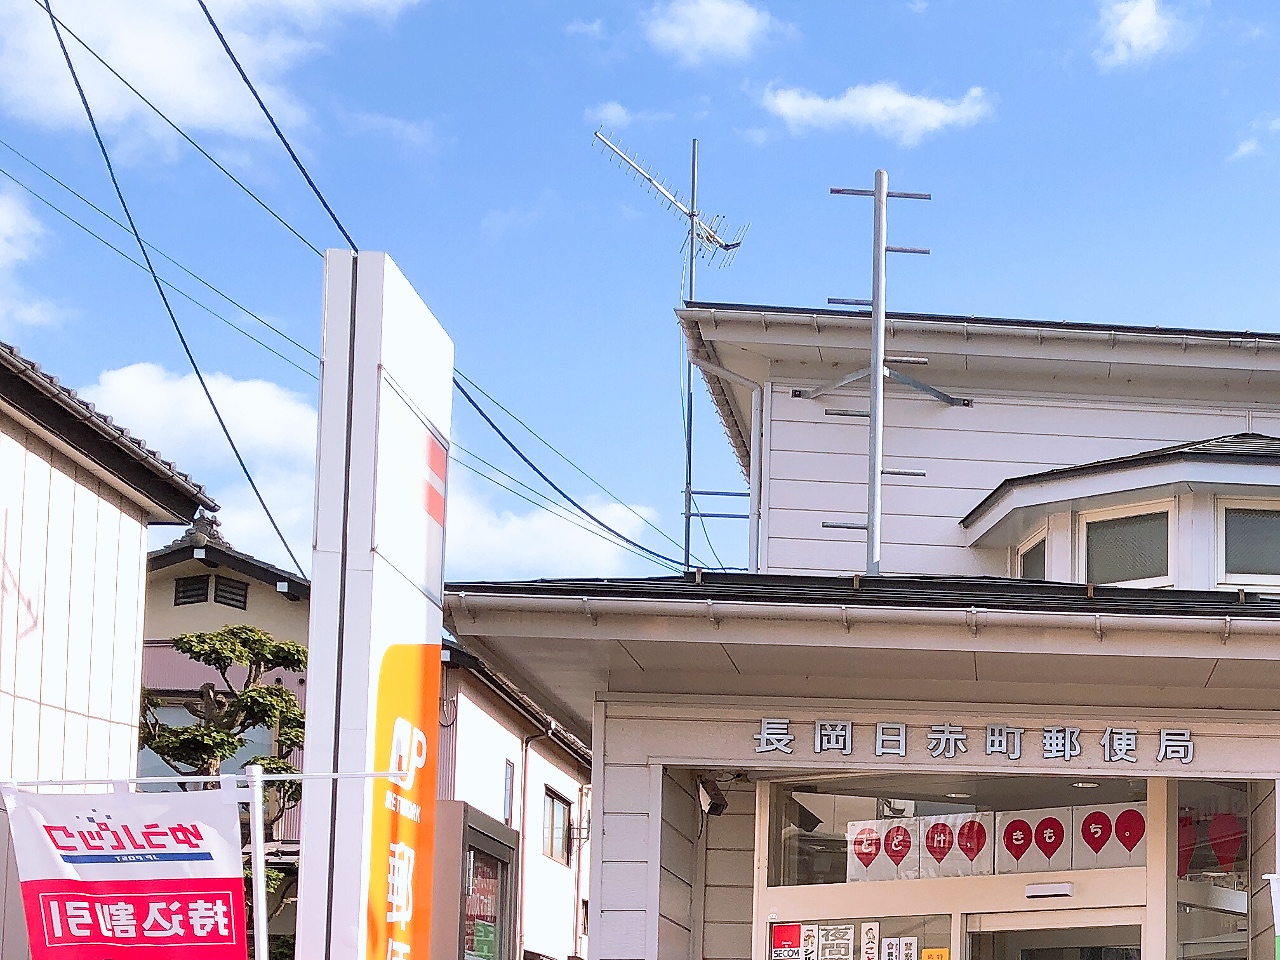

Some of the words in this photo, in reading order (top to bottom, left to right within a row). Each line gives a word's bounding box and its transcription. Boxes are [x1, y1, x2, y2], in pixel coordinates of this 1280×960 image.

[388, 716, 427, 790] JP
[754, 717, 1196, 763] 長岡日赤町郵便局
[384, 789, 421, 823] NETWORK
[773, 949, 800, 958] SECOM
